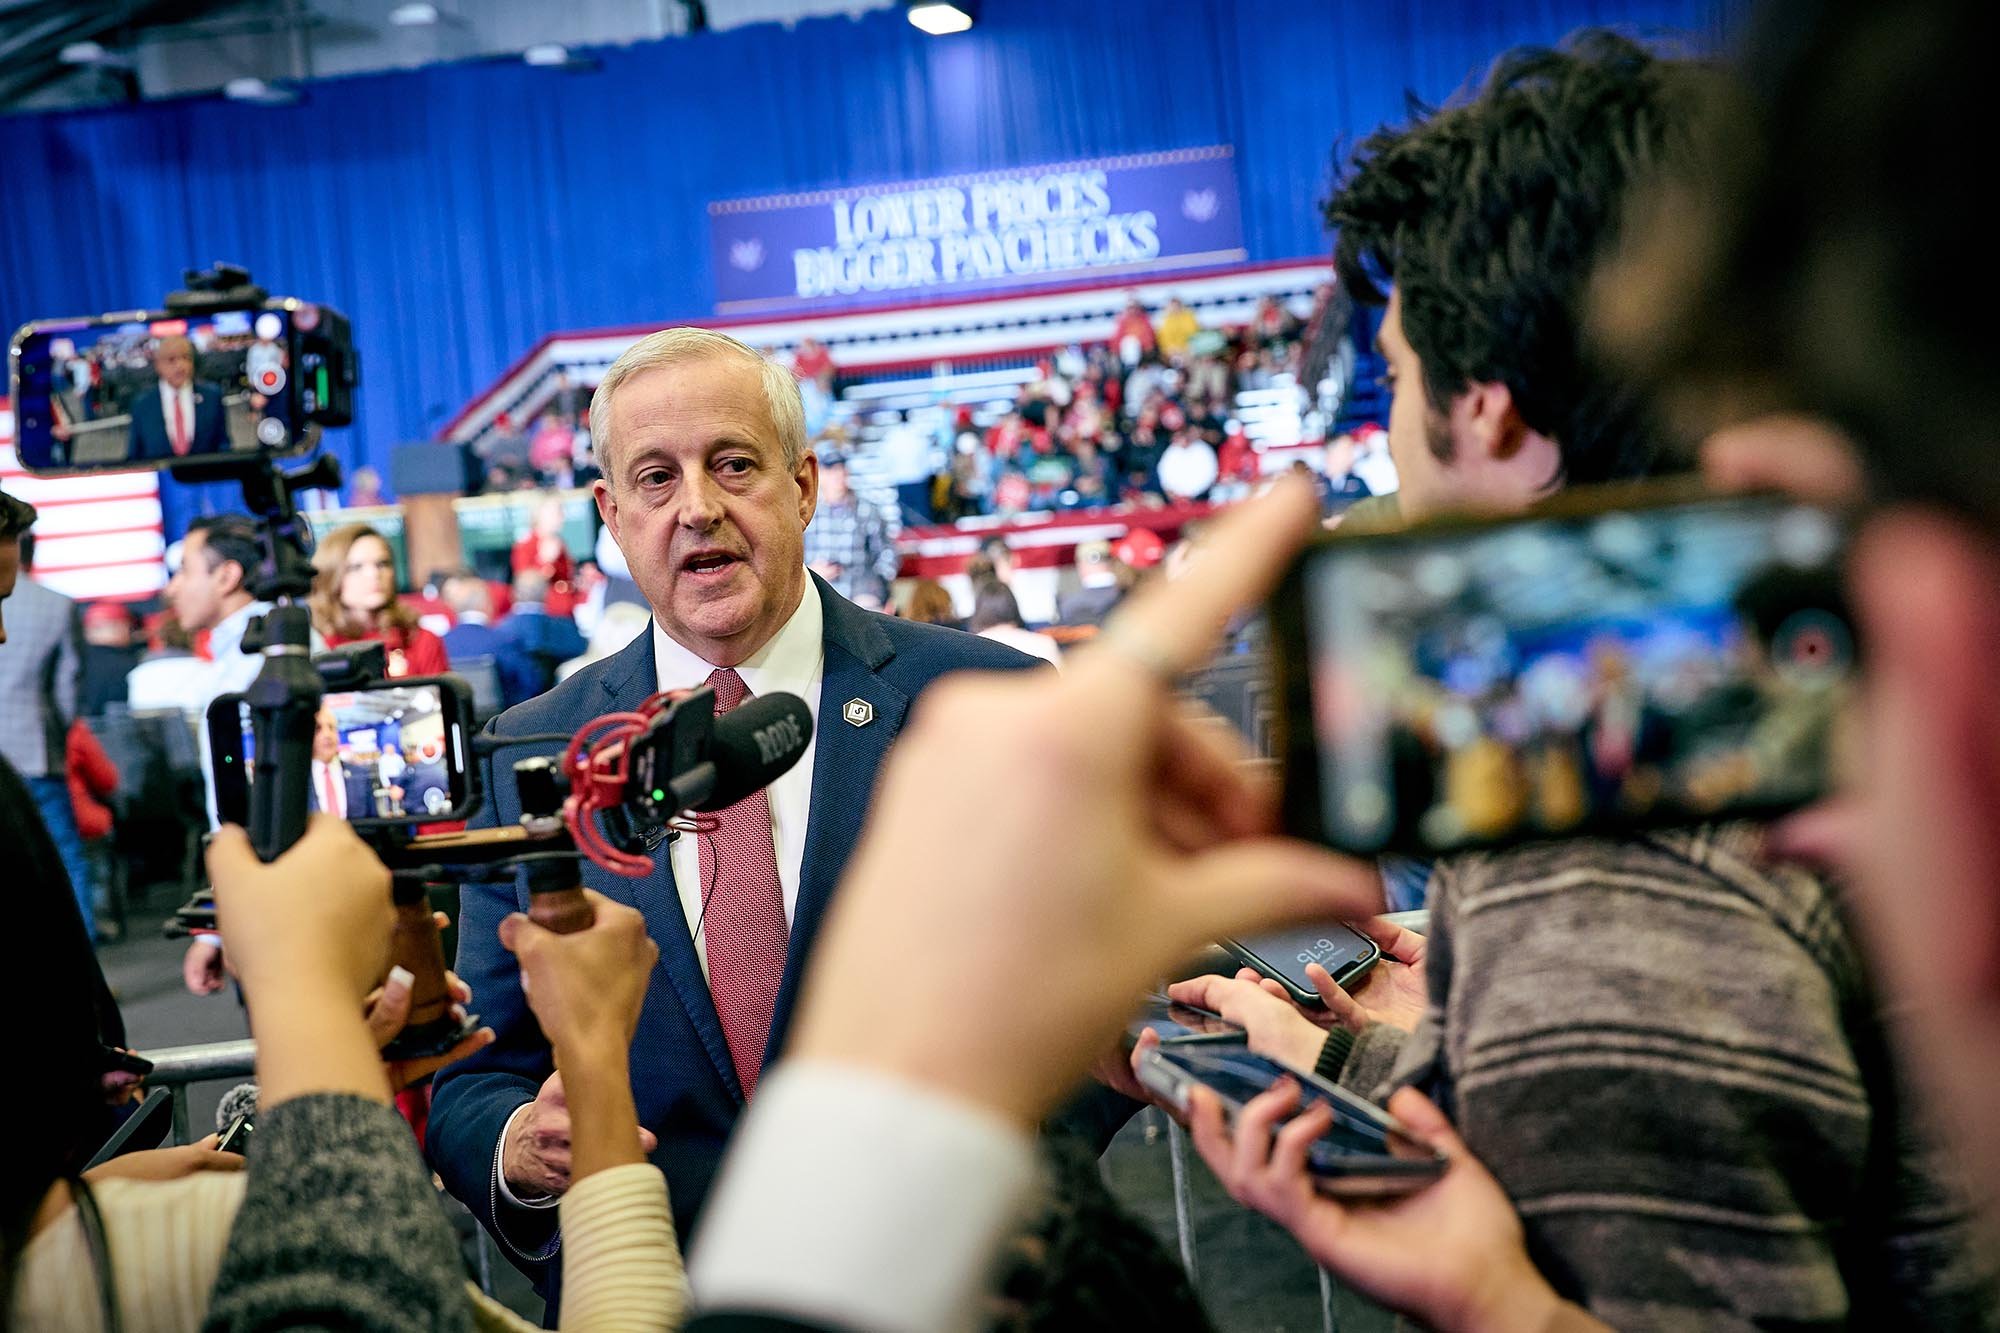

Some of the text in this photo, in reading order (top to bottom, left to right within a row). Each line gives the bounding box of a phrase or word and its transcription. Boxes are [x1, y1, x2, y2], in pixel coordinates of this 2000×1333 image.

[833, 169, 1111, 248] LOWER PRICES
[794, 211, 1161, 298] BIGGER PAYCHECKS
